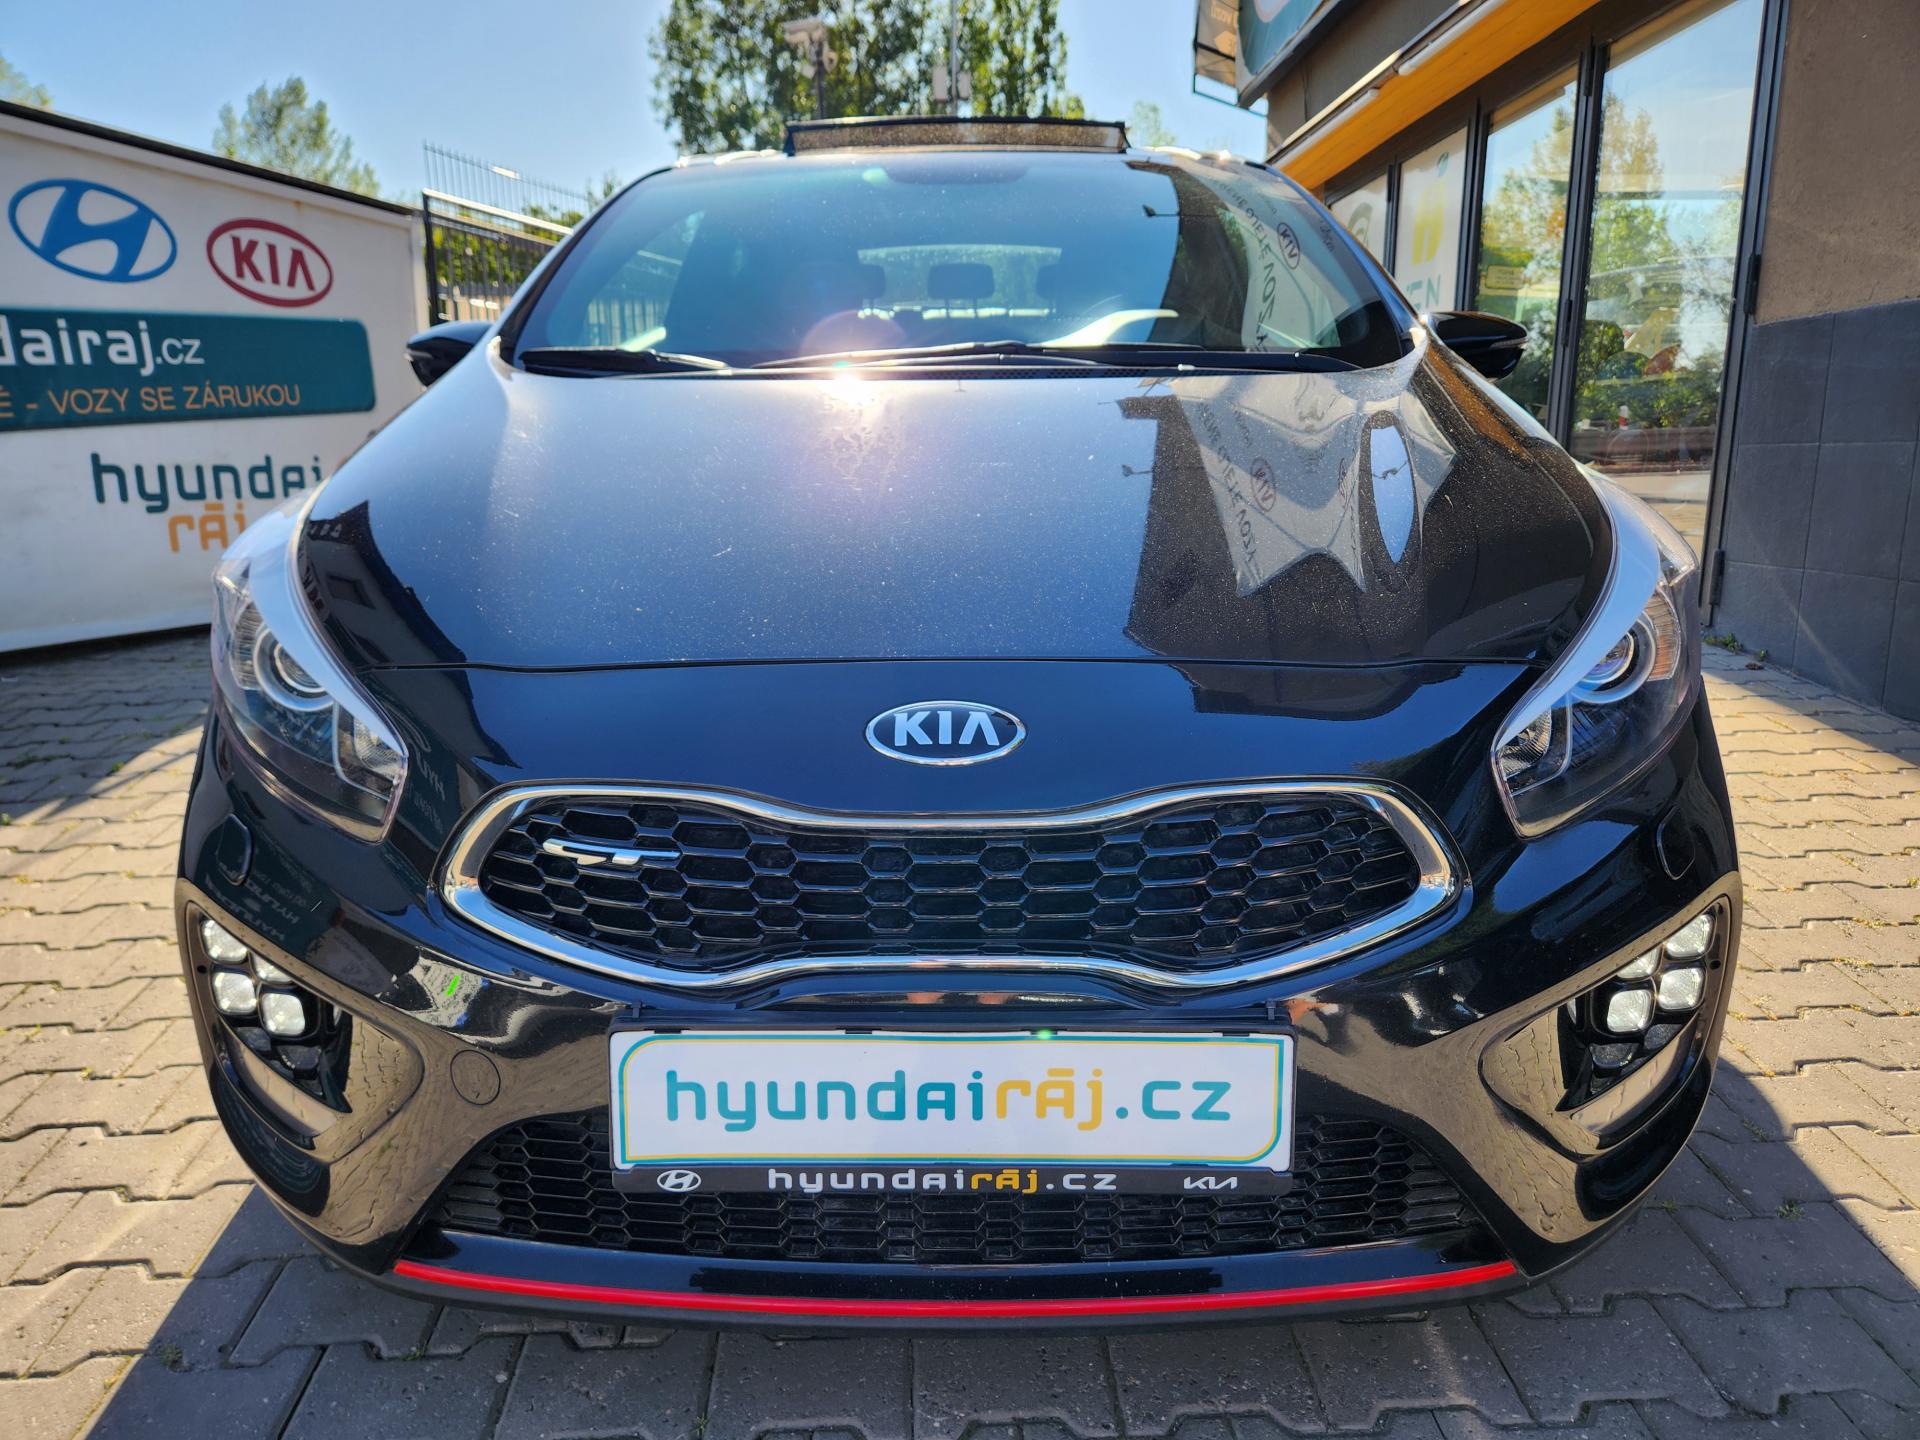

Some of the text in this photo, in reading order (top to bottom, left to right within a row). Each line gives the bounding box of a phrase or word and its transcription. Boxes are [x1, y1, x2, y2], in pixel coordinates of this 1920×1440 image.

[230, 235, 316, 292] KIA
[48, 387, 130, 416] VOZY
[140, 386, 177, 412] SE
[183, 379, 301, 409] ZÁRUKOU
[894, 711, 1000, 746] KIA
[1183, 1176, 1238, 1190] KIA
